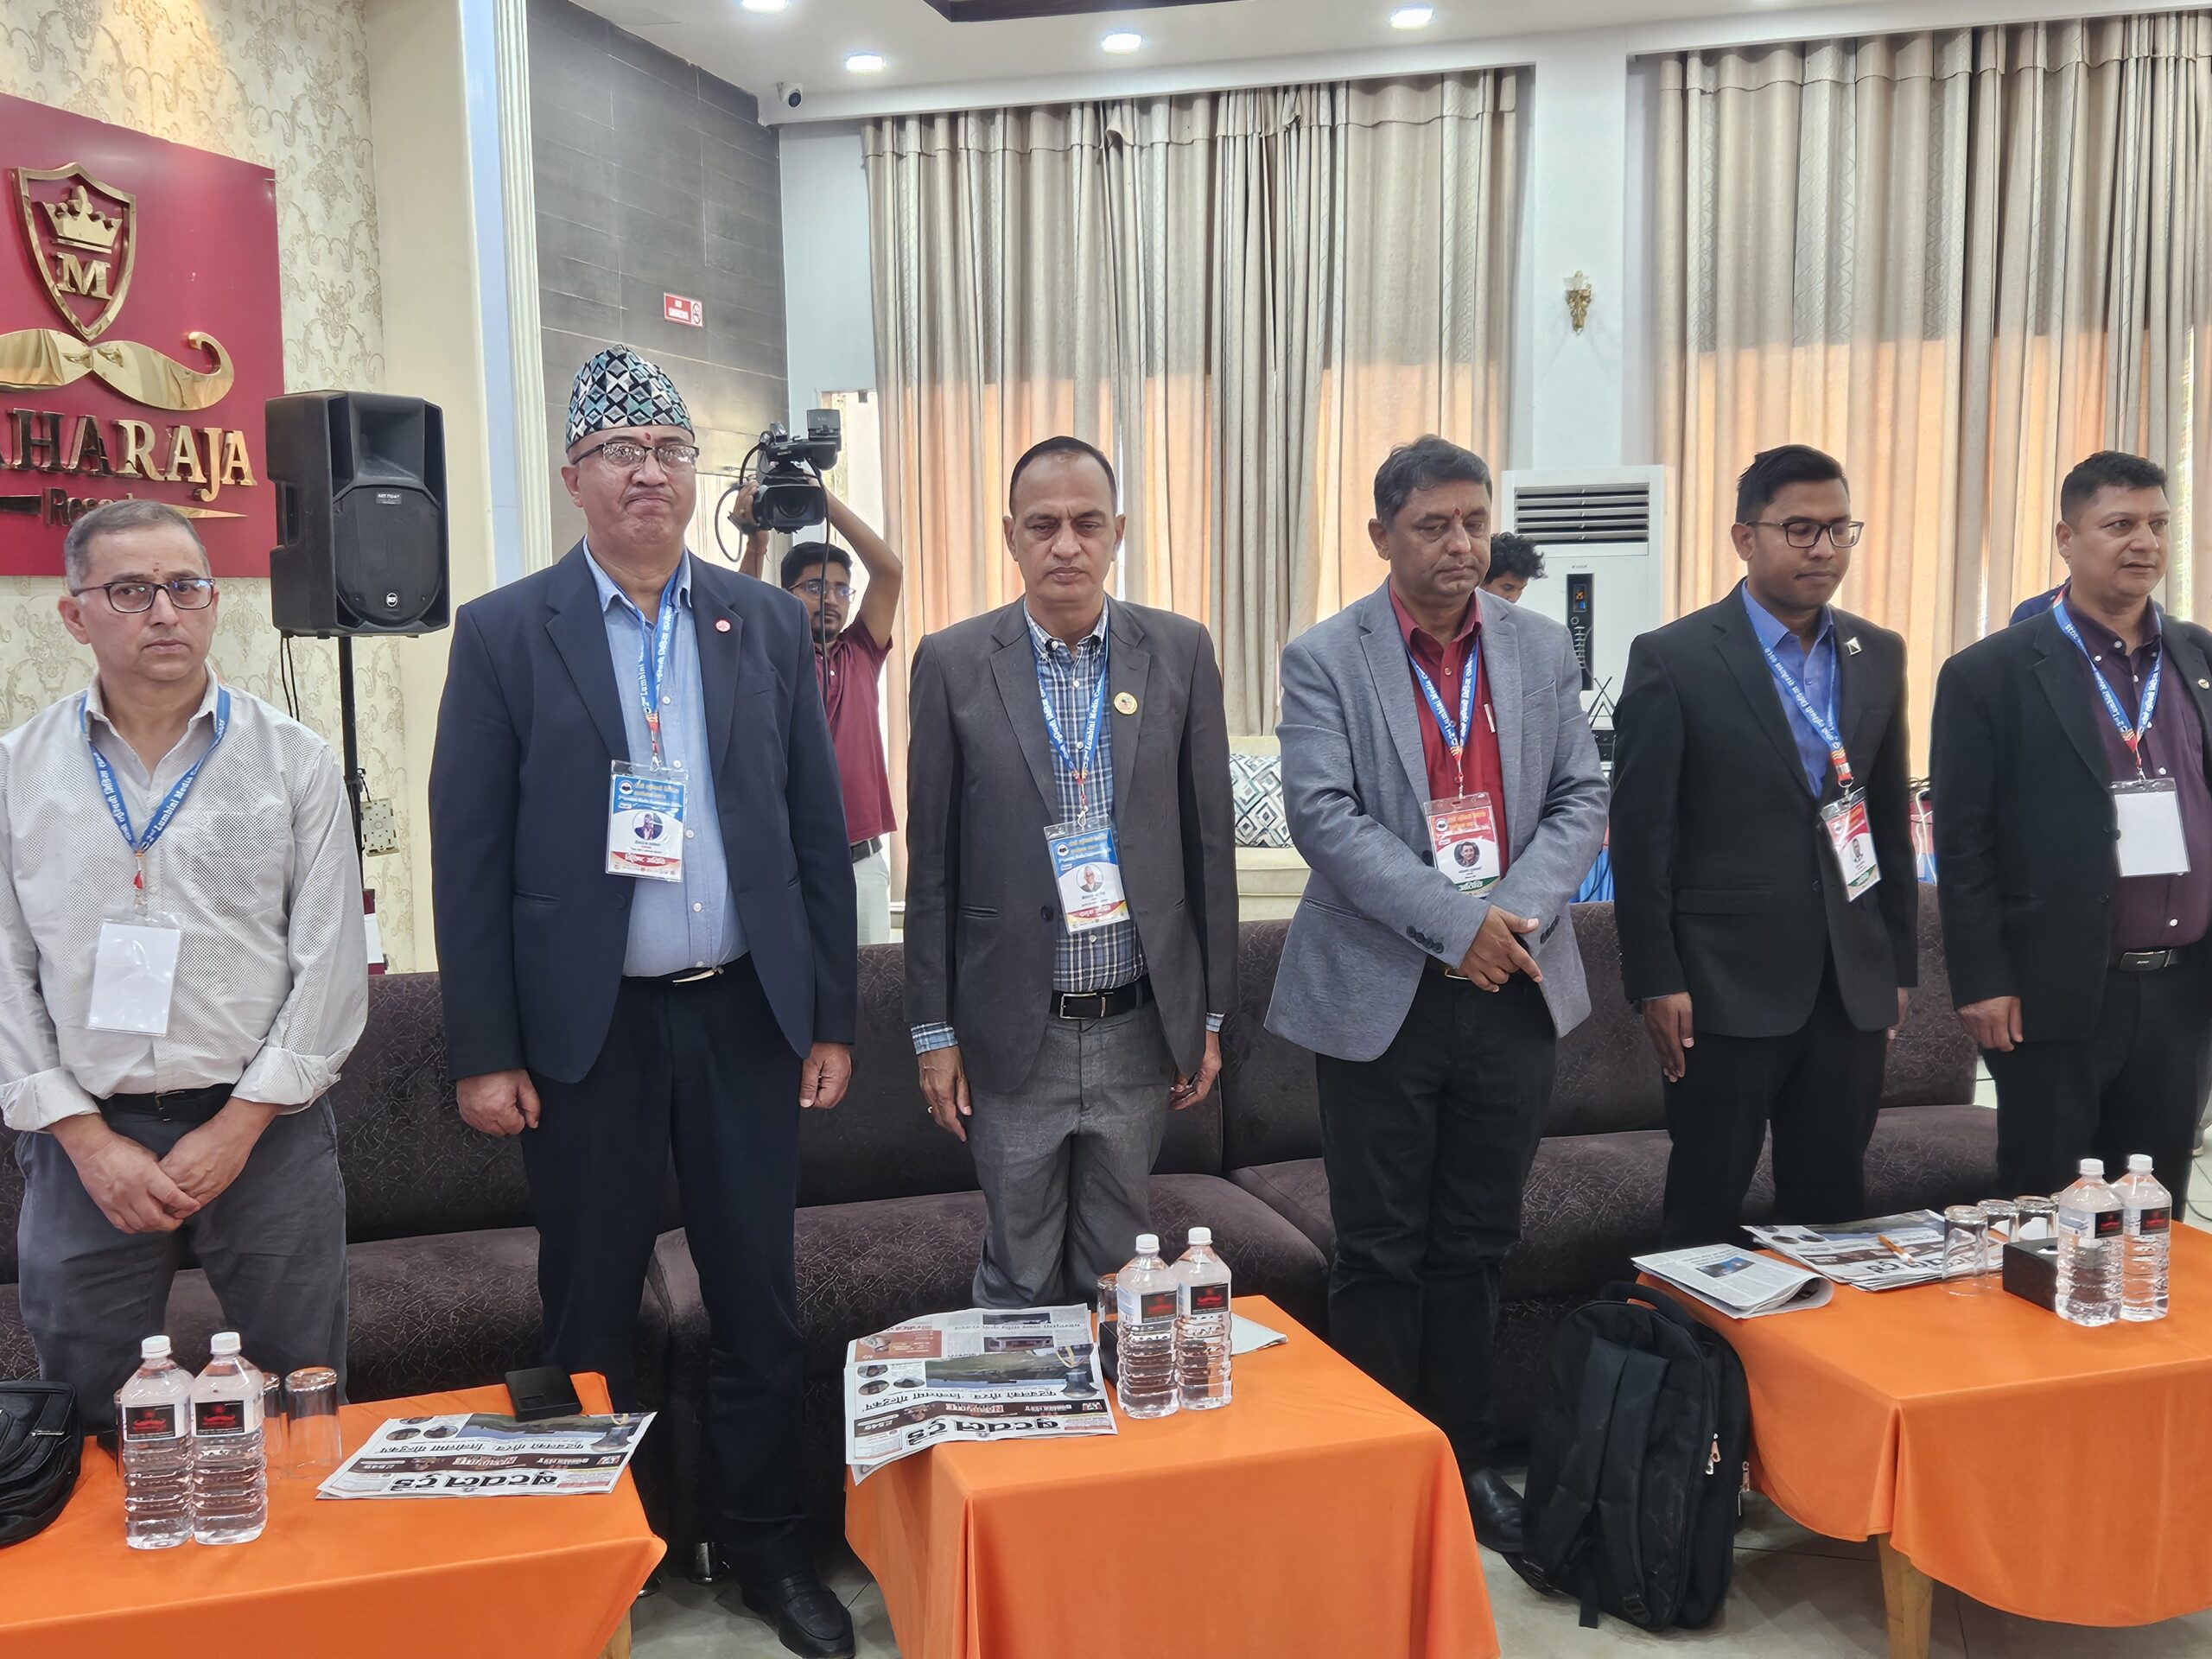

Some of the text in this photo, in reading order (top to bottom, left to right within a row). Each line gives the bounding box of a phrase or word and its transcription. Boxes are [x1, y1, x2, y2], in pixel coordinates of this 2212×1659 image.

[55, 251, 112, 300] M
[0, 408, 257, 503] HARAJA
[636, 663, 648, 696] Lumbini
[1423, 679, 1439, 701] Media
[1088, 696, 1100, 720] Media
[1432, 698, 1452, 729] Lumbini
[2101, 689, 2120, 717] Lumbini
[1083, 720, 1096, 750] Lumbini
[151, 797, 181, 832] Lumbini
[173, 773, 195, 800] Media
[906, 1419, 947, 1446] टुडे
[391, 1471, 558, 1491] बुटवल टुडे
